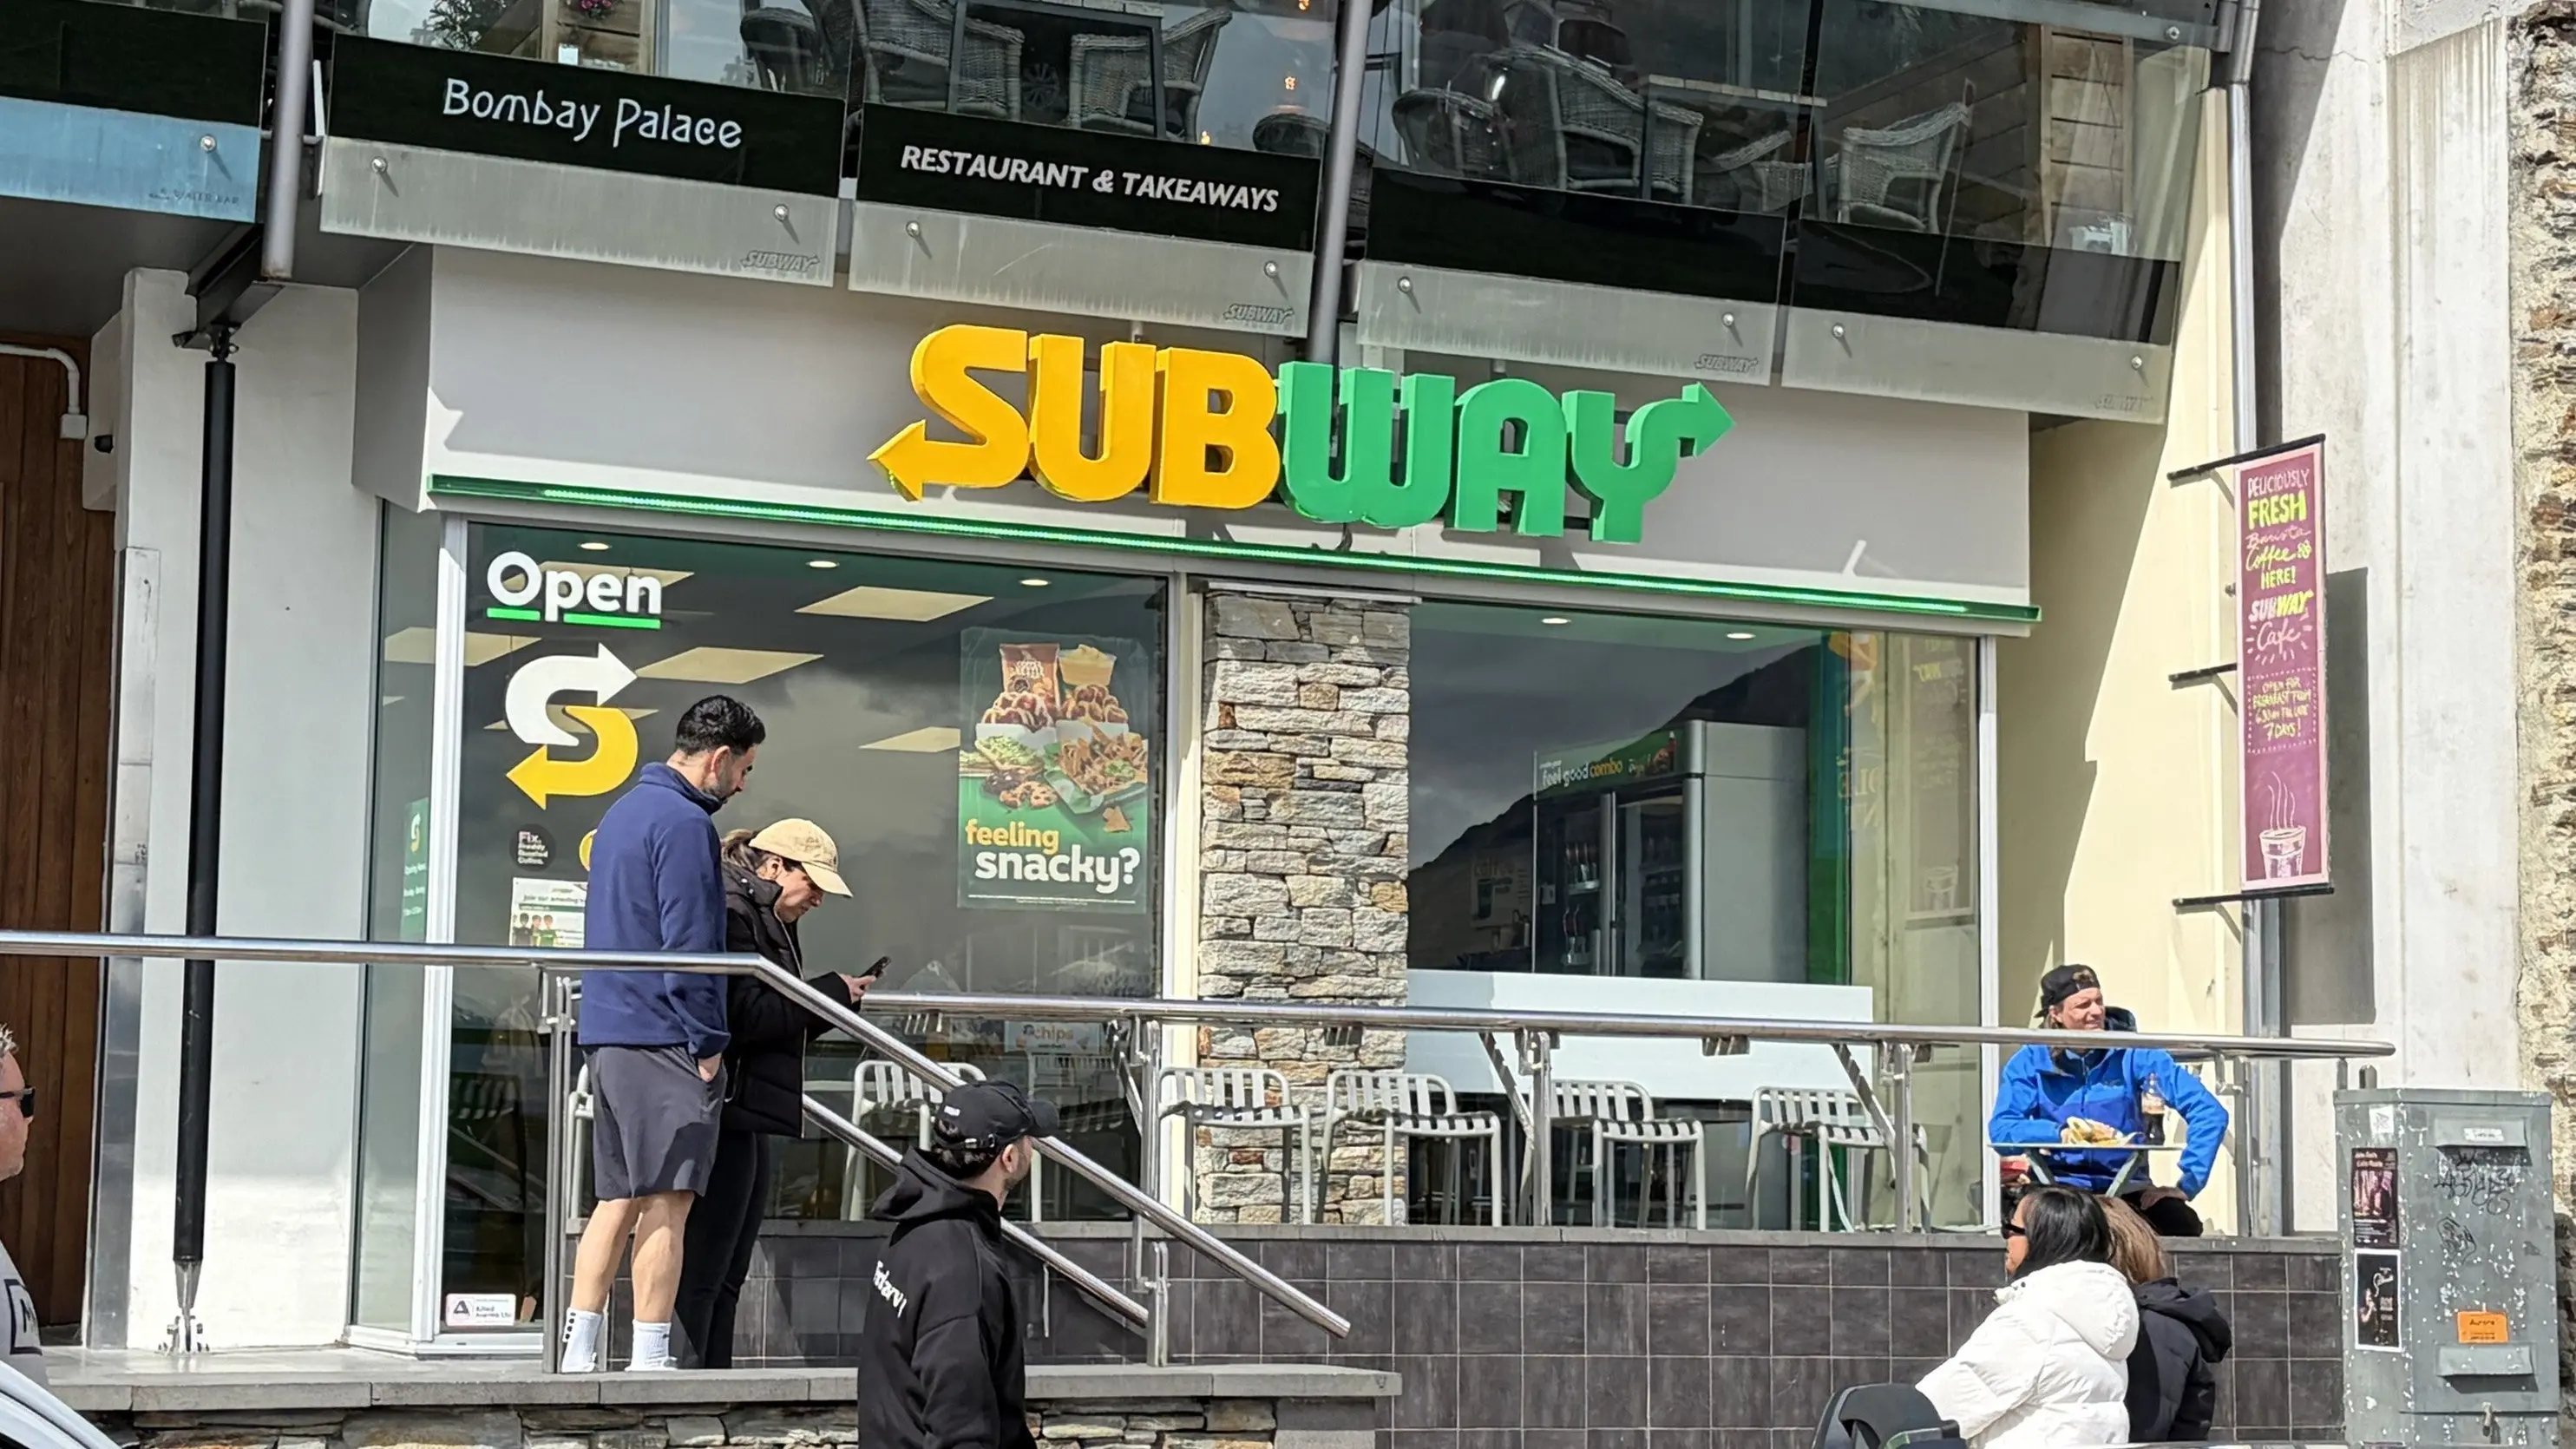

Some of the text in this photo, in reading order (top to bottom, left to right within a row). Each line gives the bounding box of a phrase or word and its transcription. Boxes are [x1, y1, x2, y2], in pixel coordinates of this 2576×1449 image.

[442, 78, 742, 148] Bombay Palace
[901, 145, 1279, 212] RESTAURANT & TAKEAWAYS
[740, 249, 821, 273] SUBWAY
[1222, 303, 1295, 325] SUBWAY
[1694, 352, 1760, 373] SUBWAY
[868, 324, 1734, 543] SUBWAY
[2247, 469, 2310, 499] DELICIOUSLY
[2247, 489, 2307, 530] FRESH
[2245, 525, 2312, 549] Barista
[2245, 544, 2297, 572] Coffee
[487, 551, 661, 622] Open
[2260, 565, 2297, 590] HERE!
[2248, 589, 2314, 623] SUBWAY
[1563, 762, 1589, 787] good
[1589, 757, 1623, 778] combo
[965, 818, 1059, 855] feeling
[975, 844, 1140, 894] snacky?
